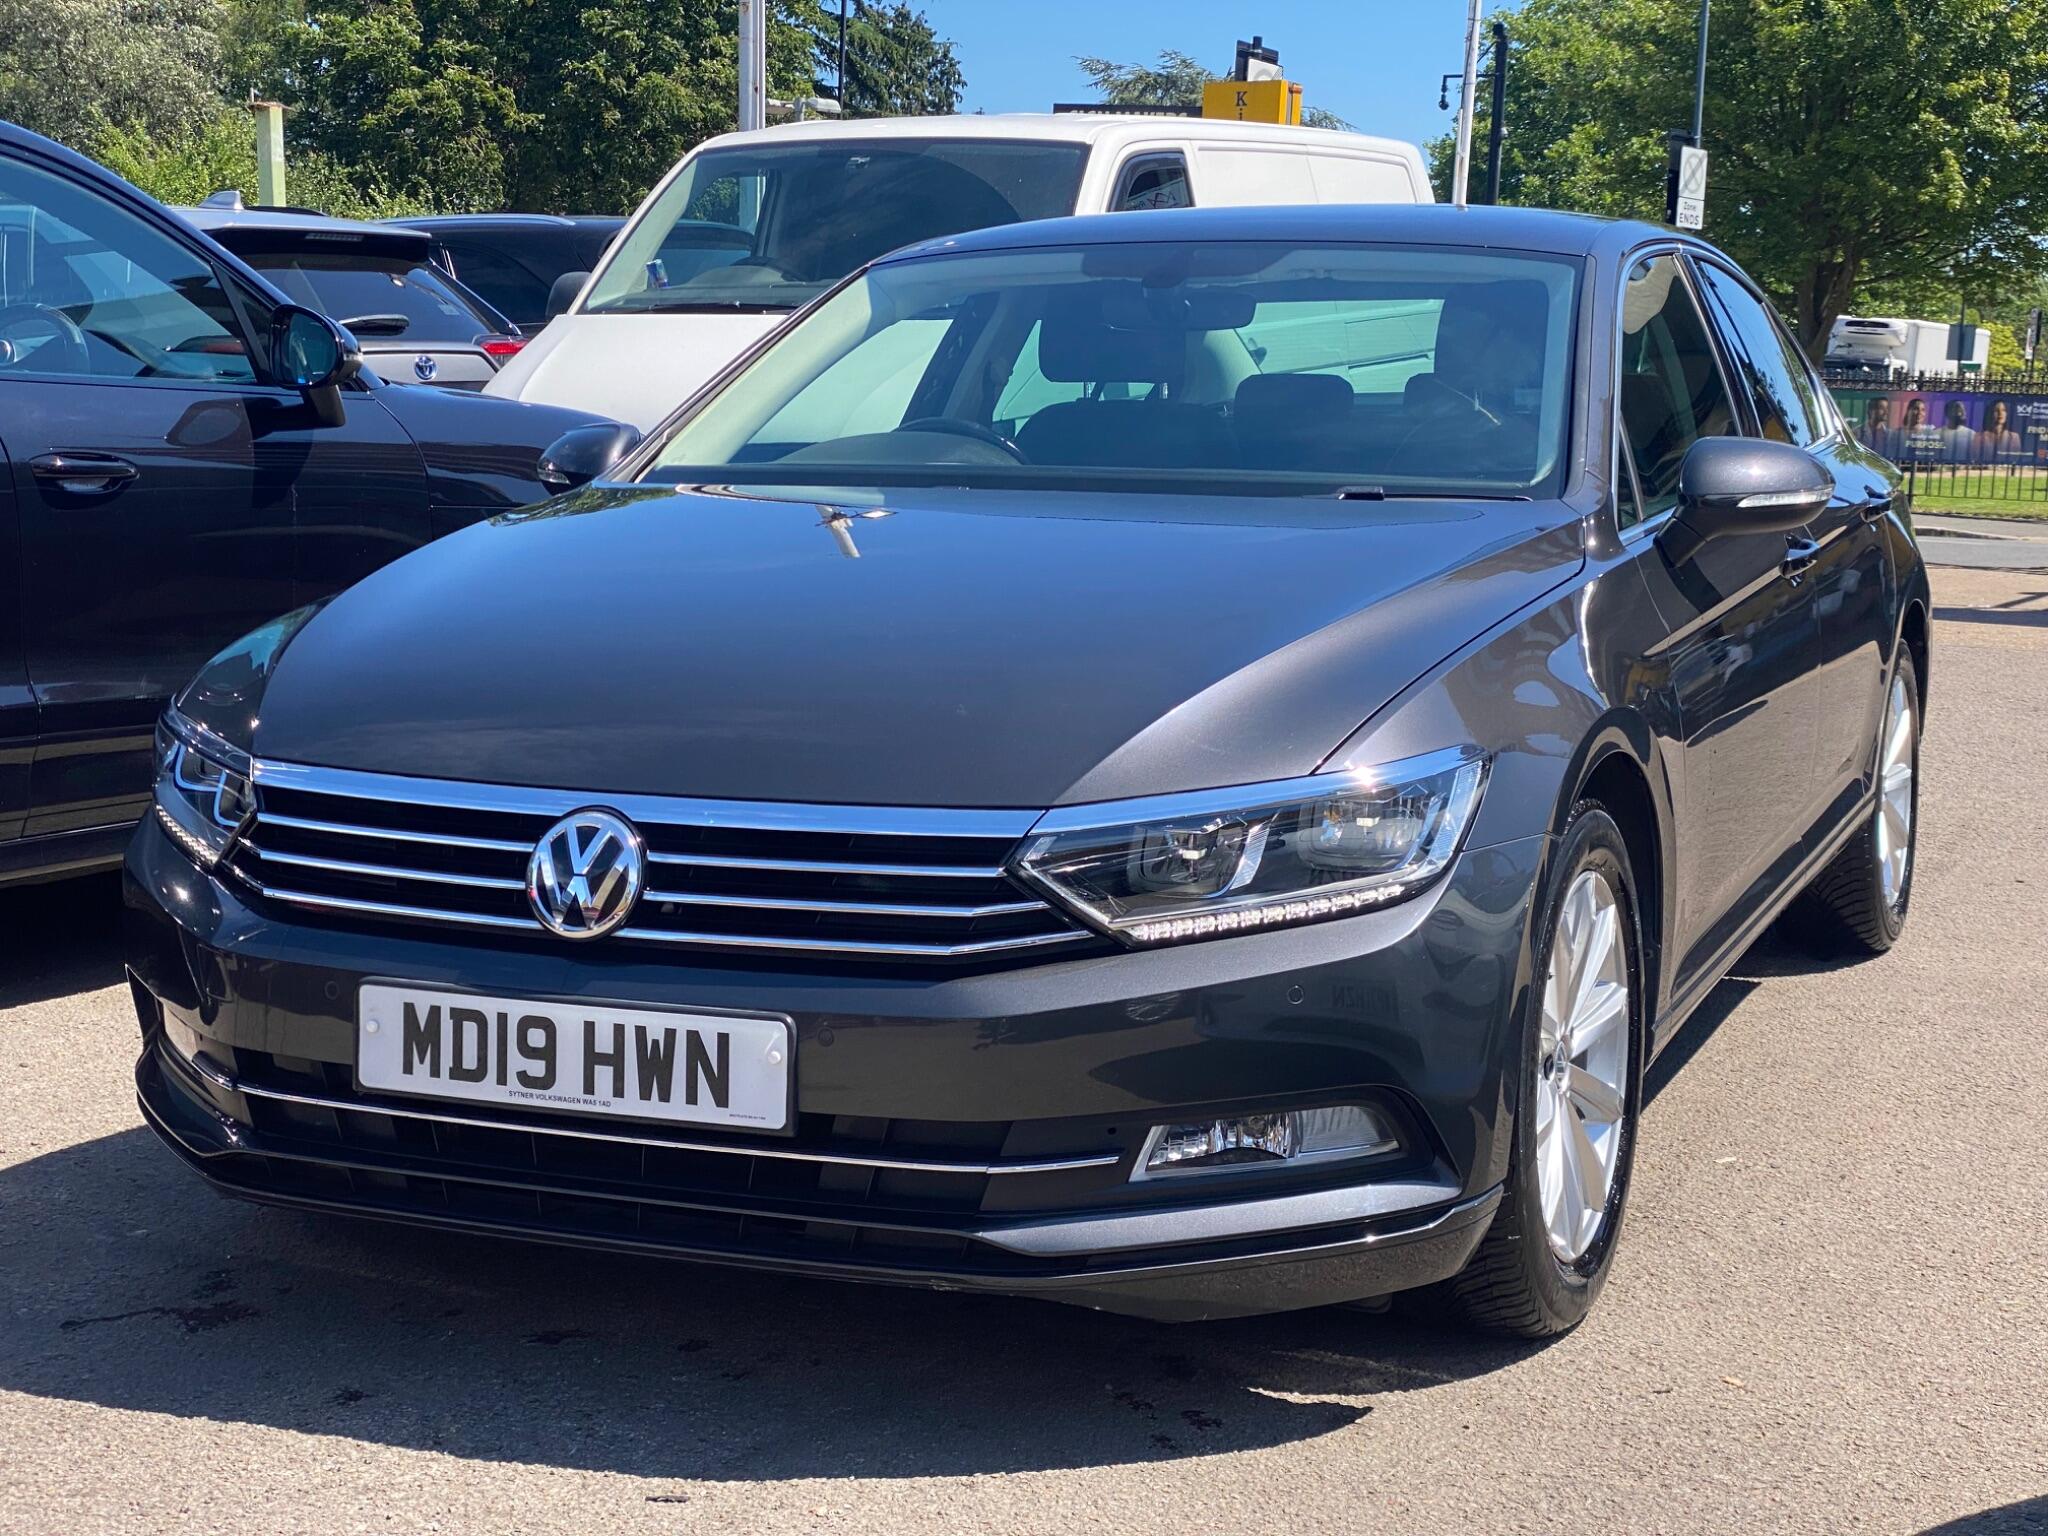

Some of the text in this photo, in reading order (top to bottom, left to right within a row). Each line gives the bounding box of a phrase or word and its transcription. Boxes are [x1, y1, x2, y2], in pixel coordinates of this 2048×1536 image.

[1683, 201, 1697, 212] Zone
[1679, 212, 1700, 226] ENDS
[402, 1001, 730, 1109] MD19 HWN
[508, 1090, 535, 1099] SYTNER
[535, 1093, 581, 1104] VOLKSWAGEN
